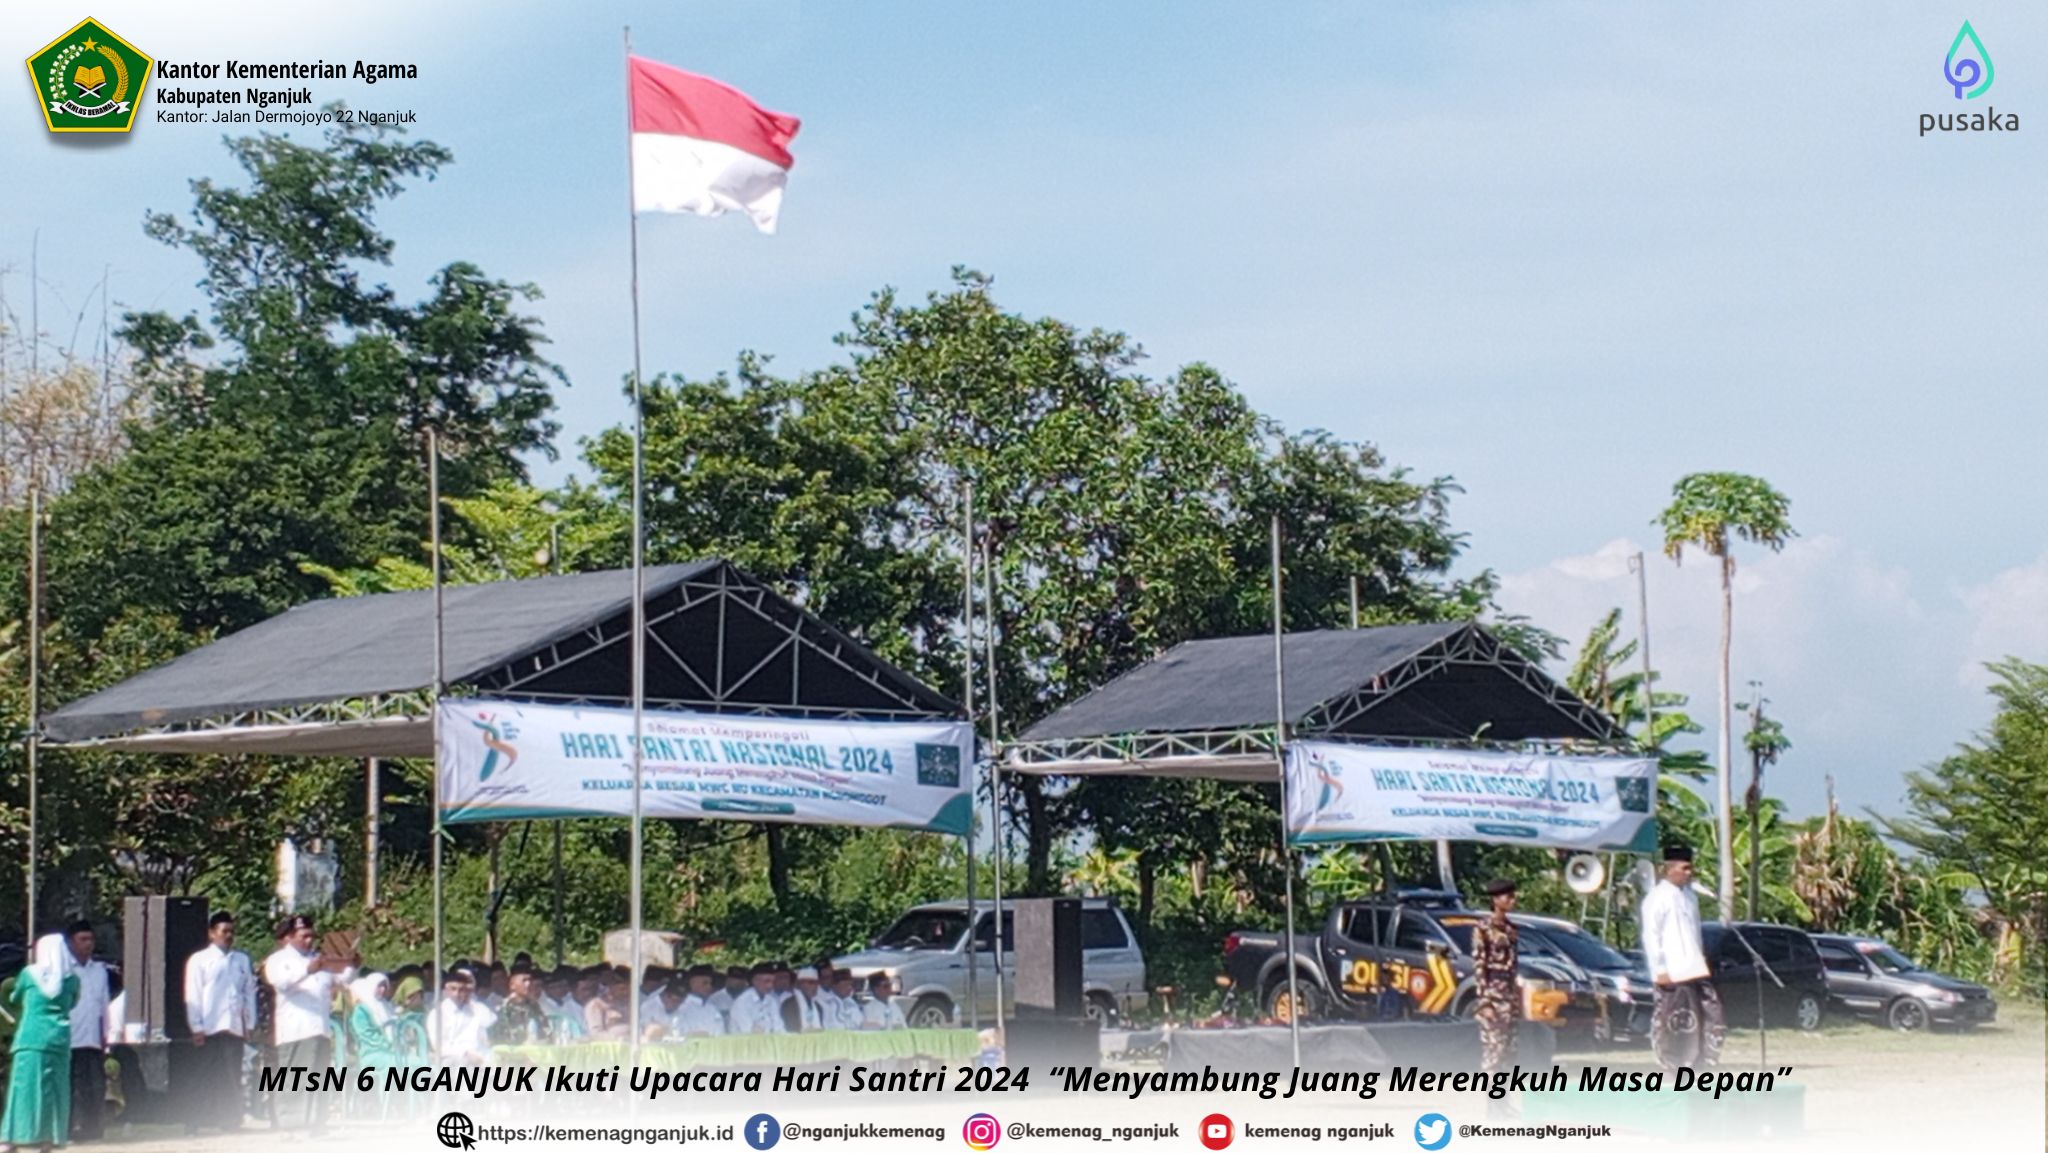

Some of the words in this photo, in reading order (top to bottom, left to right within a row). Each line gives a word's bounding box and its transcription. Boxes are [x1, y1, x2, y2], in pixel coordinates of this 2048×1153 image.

[560, 732, 623, 759] HARI
[720, 740, 834, 771] NASIONAL
[838, 747, 893, 774] 2024
[582, 779, 653, 791] KELUARA
[656, 781, 696, 792] BESAR
[1371, 768, 1418, 791] HARI
[1417, 771, 1482, 794] SANTRI
[1557, 780, 1600, 803] 2024
